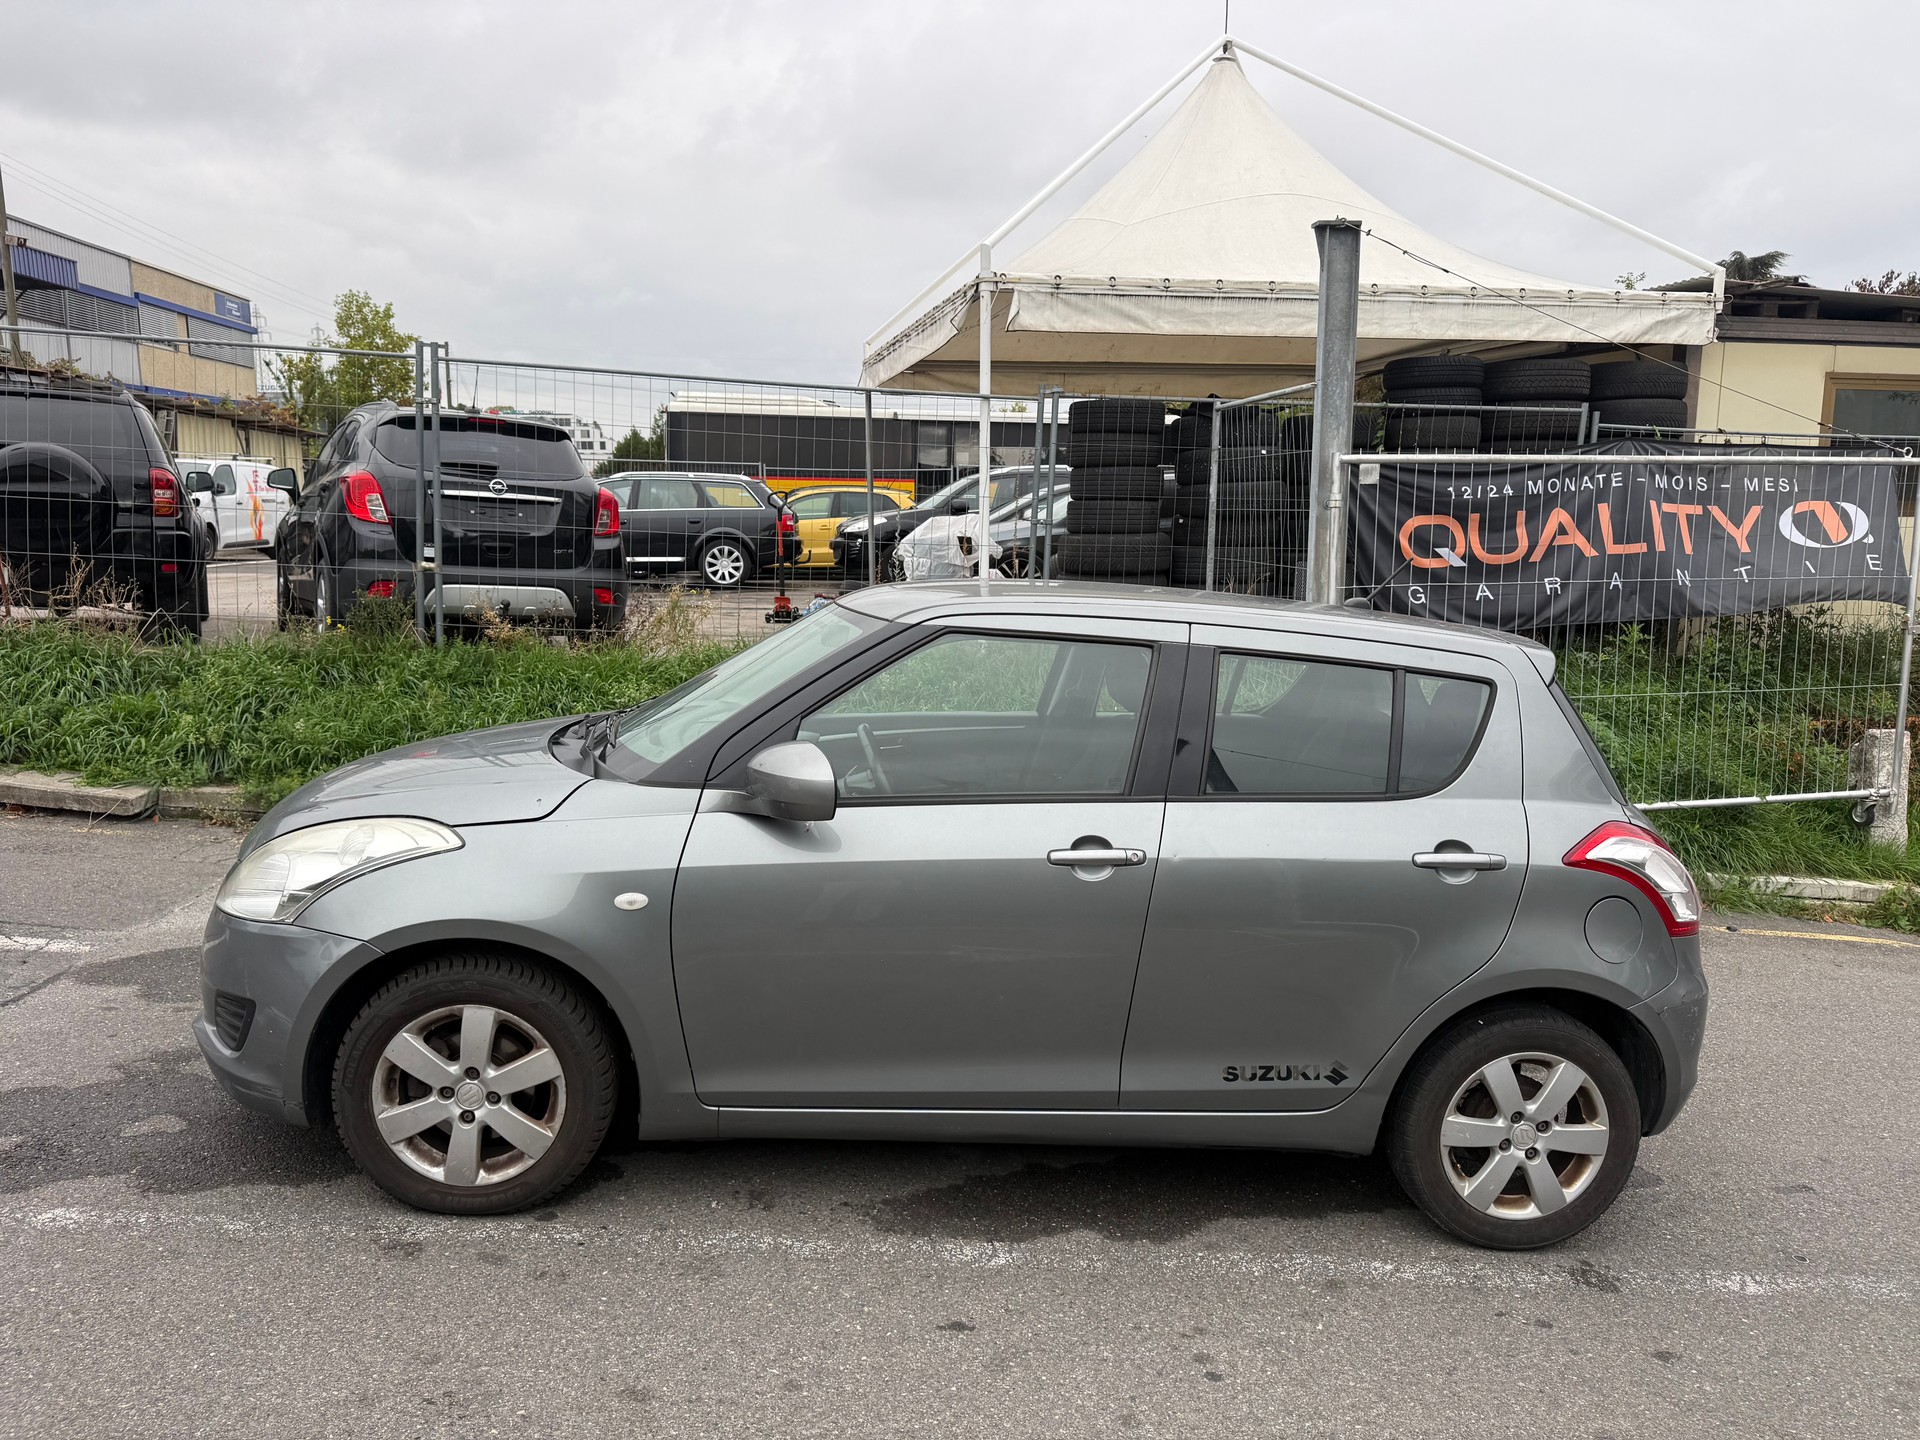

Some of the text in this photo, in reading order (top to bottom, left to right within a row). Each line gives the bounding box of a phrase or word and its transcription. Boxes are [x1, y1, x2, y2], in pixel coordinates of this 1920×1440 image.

[1446, 484, 1514, 500] 12/24
[1527, 472, 1623, 495] MONATE
[1655, 474, 1708, 492] MOIS
[1744, 477, 1799, 492] MESI
[1399, 500, 1764, 569] QUALITY
[1408, 554, 1883, 604] GARANTIE
[1222, 1065, 1321, 1082] SUZUKI
